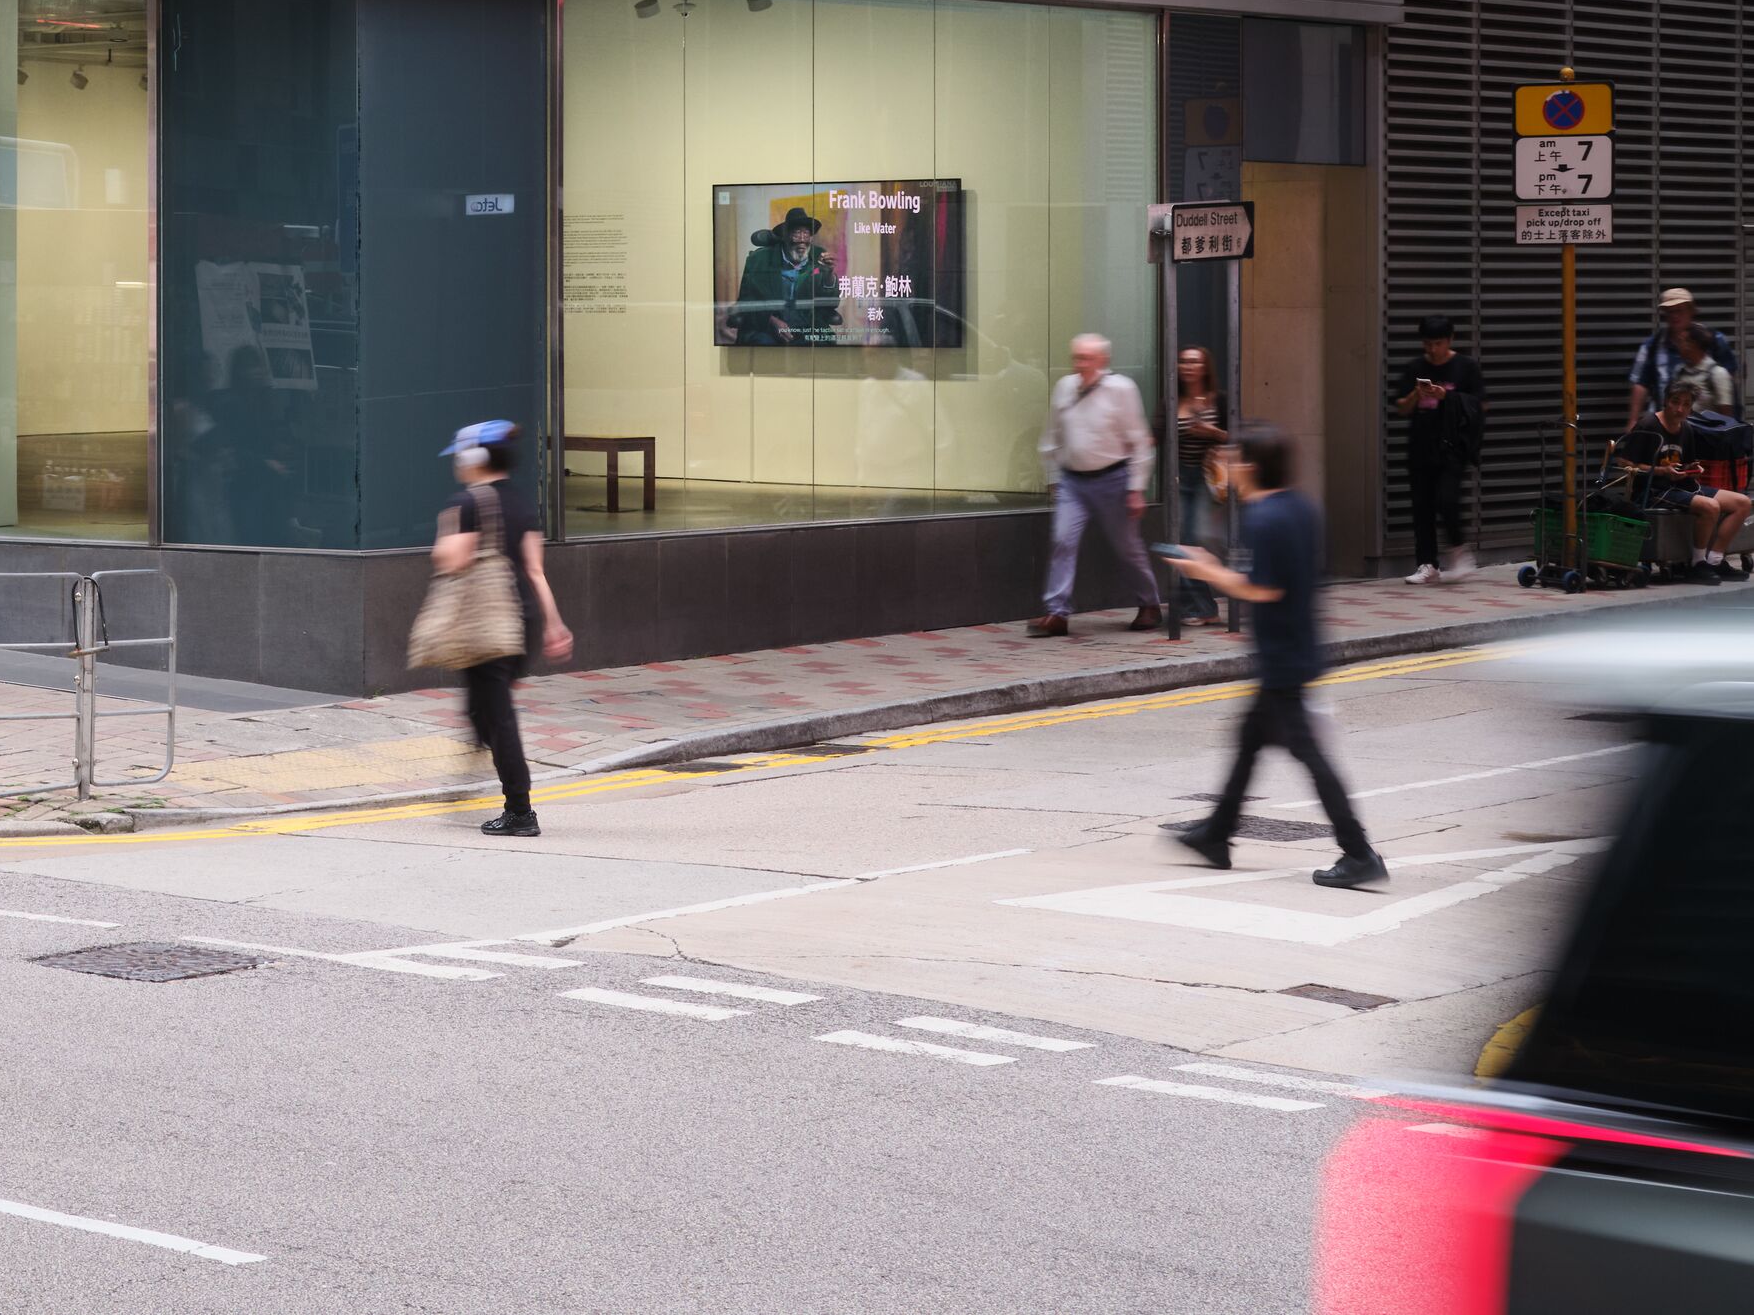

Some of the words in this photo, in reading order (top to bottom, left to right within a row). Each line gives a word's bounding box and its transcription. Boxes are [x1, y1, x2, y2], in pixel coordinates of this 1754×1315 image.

[1534, 151, 1562, 162] 上午
[1539, 140, 1556, 148] am
[1577, 140, 1593, 161] 7
[1534, 184, 1562, 195] 下午
[1539, 173, 1557, 183] pm
[1577, 174, 1593, 195] 7
[829, 189, 866, 209] Frank
[868, 190, 921, 214] Bowling
[1176, 212, 1208, 227] Duddell
[1210, 212, 1238, 226] Street
[1538, 208, 1570, 218] Except
[1572, 208, 1590, 217] taxi
[854, 222, 871, 234] Like
[872, 222, 897, 235] Water
[1526, 219, 1546, 228] pick
[1548, 218, 1585, 228] up/drop
[1587, 217, 1602, 227] off
[1521, 229, 1607, 241] 的士上落客除外
[1181, 235, 1233, 254] 都爹利街
[867, 307, 884, 321] 若水
